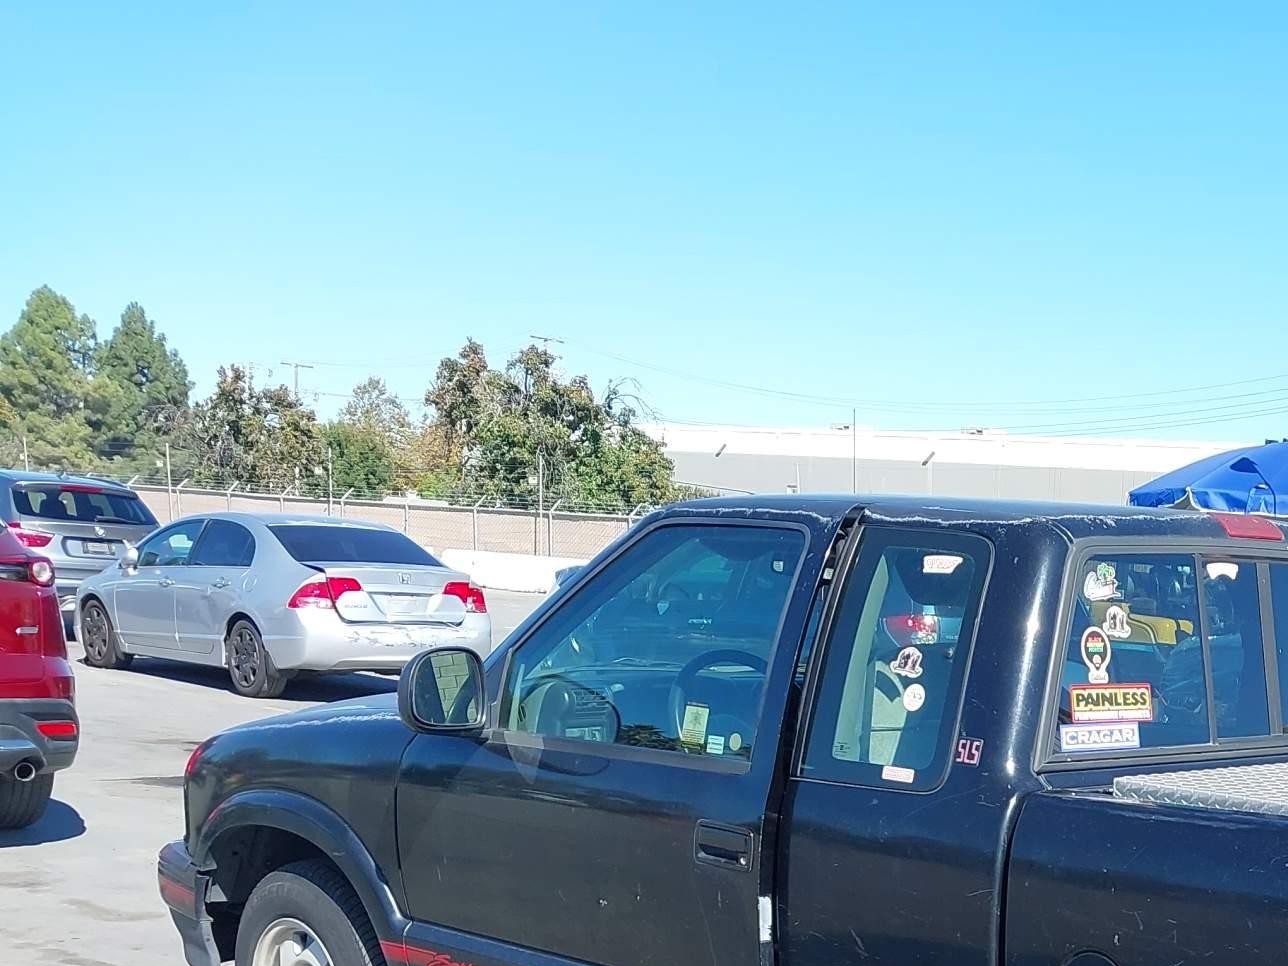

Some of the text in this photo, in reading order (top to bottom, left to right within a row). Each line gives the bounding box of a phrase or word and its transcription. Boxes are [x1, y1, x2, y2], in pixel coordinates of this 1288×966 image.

[1075, 692, 1147, 707] PAINLESS
[1066, 728, 1134, 745] CRAGAR
[956, 739, 981, 764] SLS
